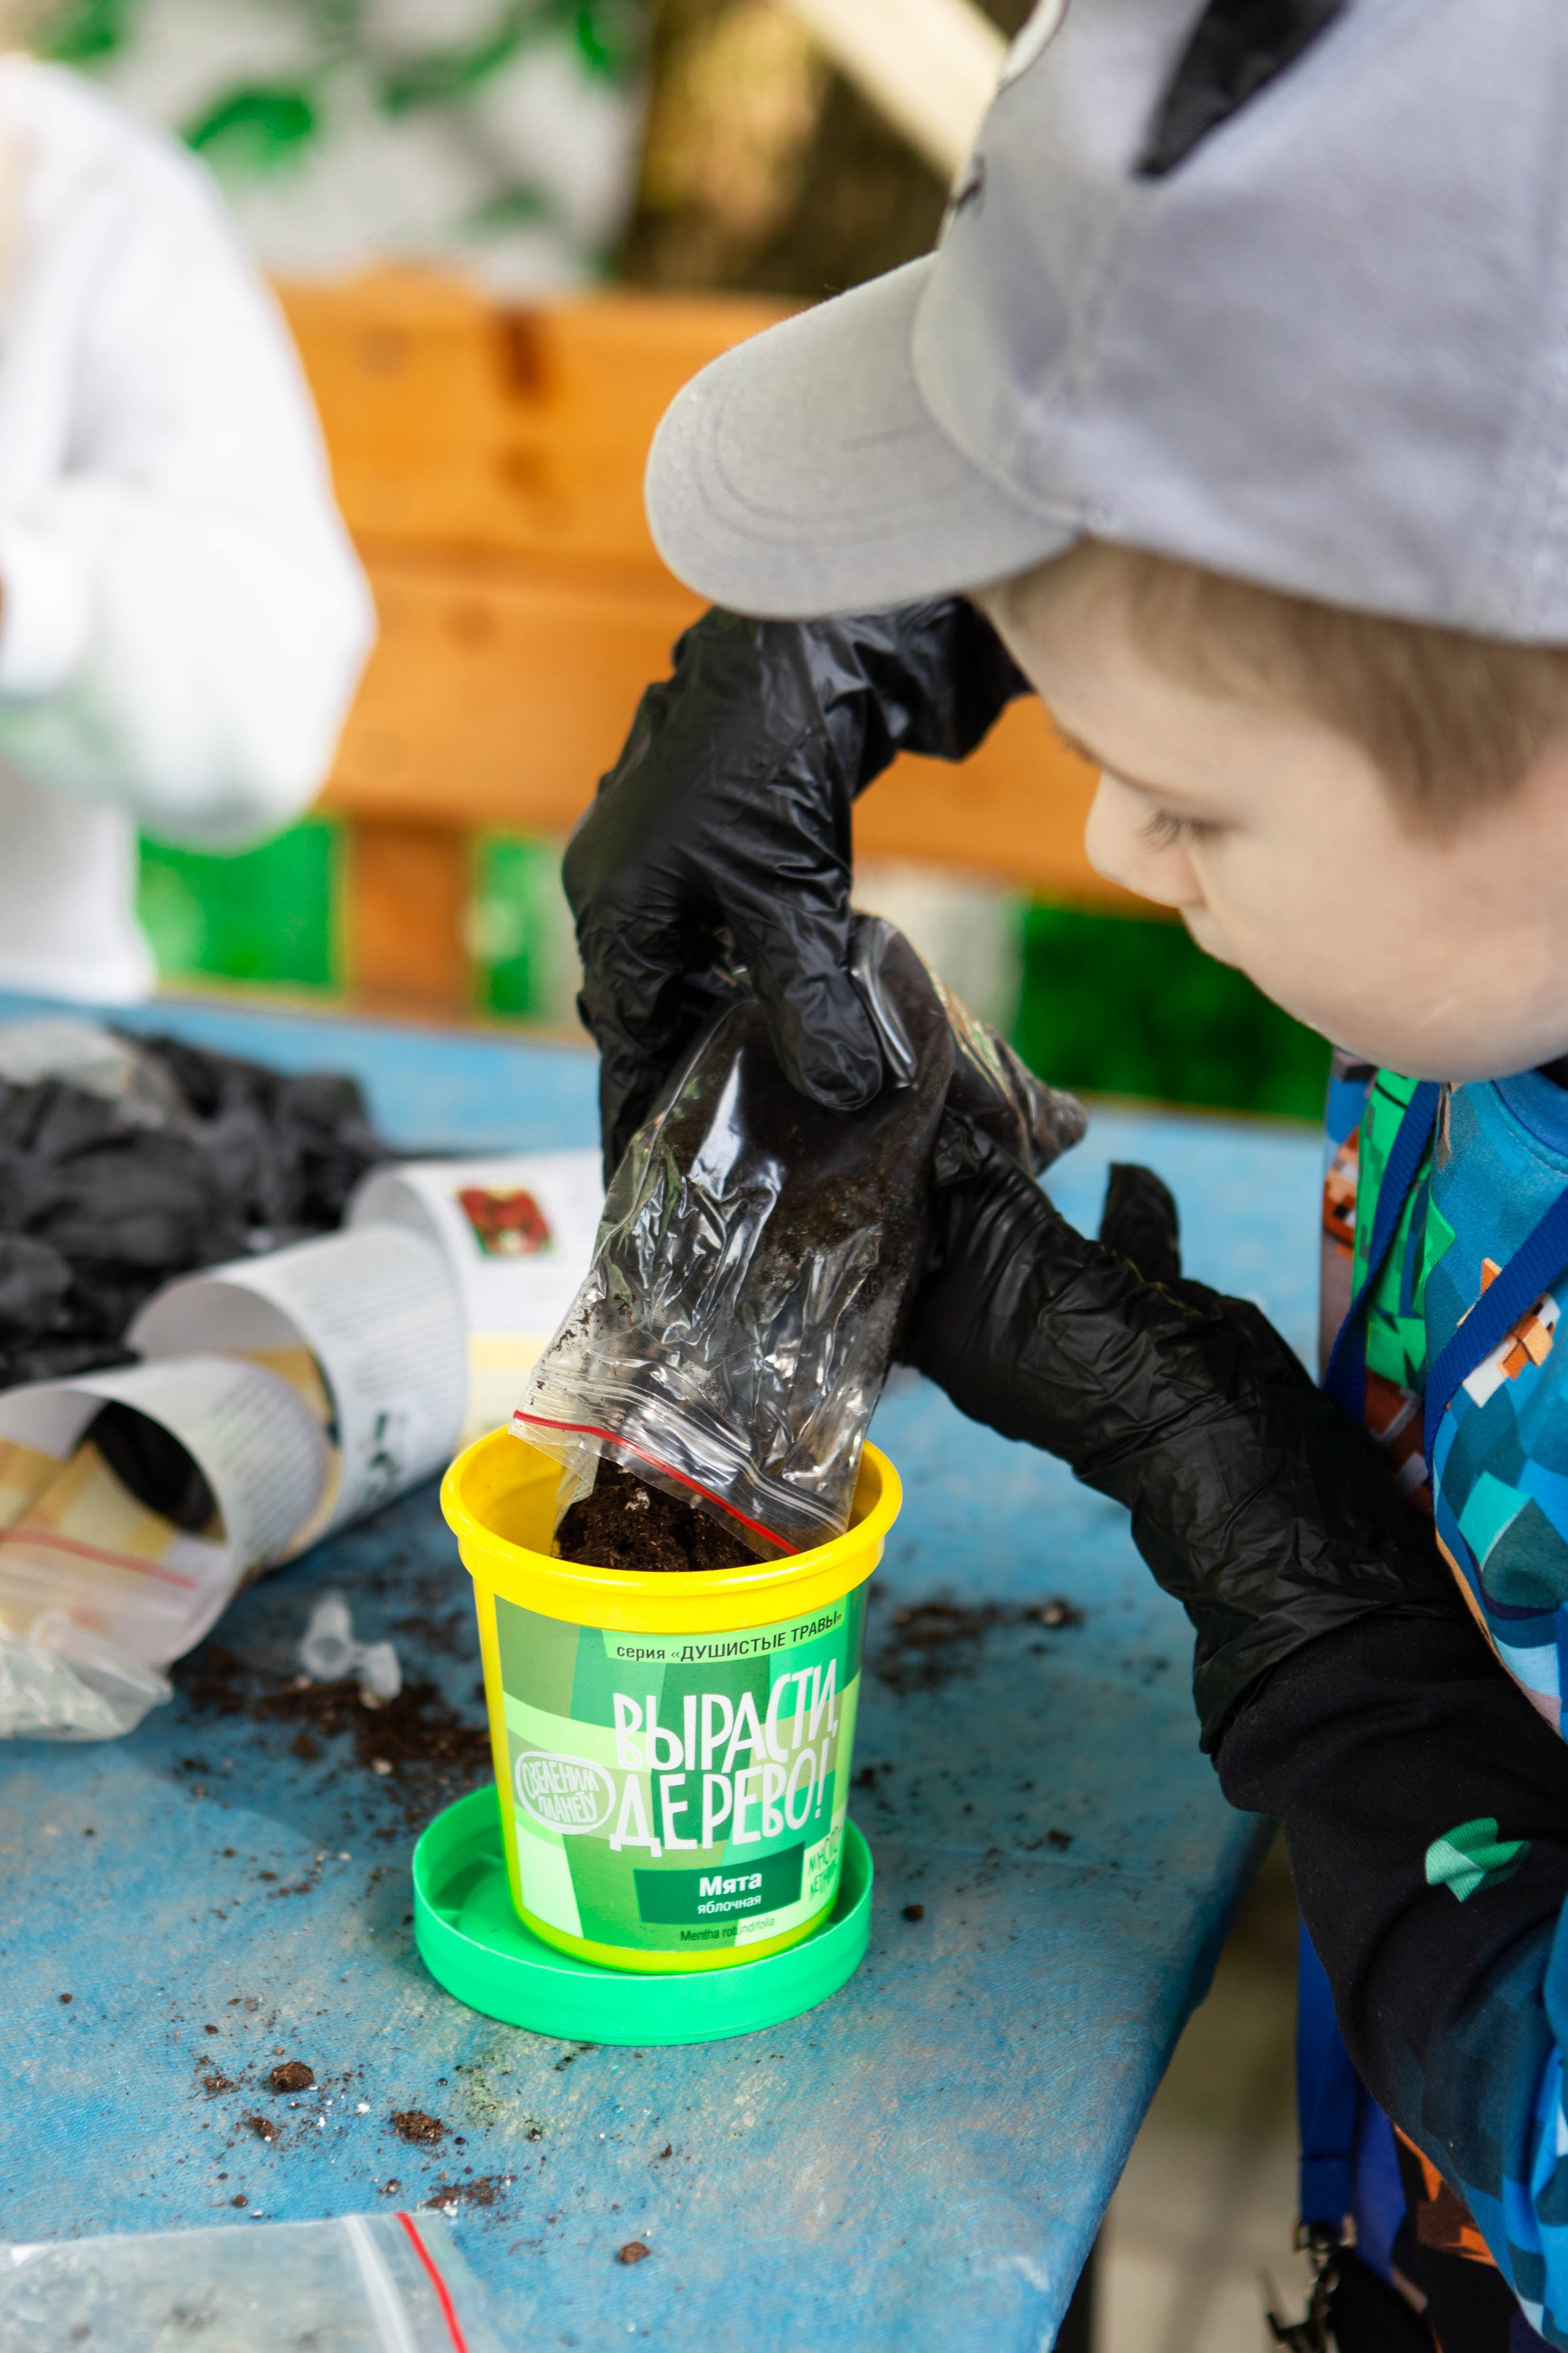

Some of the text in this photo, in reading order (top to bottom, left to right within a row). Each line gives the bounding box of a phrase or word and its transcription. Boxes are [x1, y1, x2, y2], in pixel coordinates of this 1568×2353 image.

[616, 1645, 666, 1662] серия
[671, 1632, 786, 1663] «ДУШИСТЫЕ
[613, 1658, 839, 1773] ВЫРАСТИ,
[538, 1791, 598, 1823] ПЛАНЕТУ
[610, 1737, 830, 1857] ДЕРЕВО!
[699, 1873, 762, 1897] Мята
[697, 1895, 761, 1914] яблочная
[680, 1930, 720, 1941] Mentha
